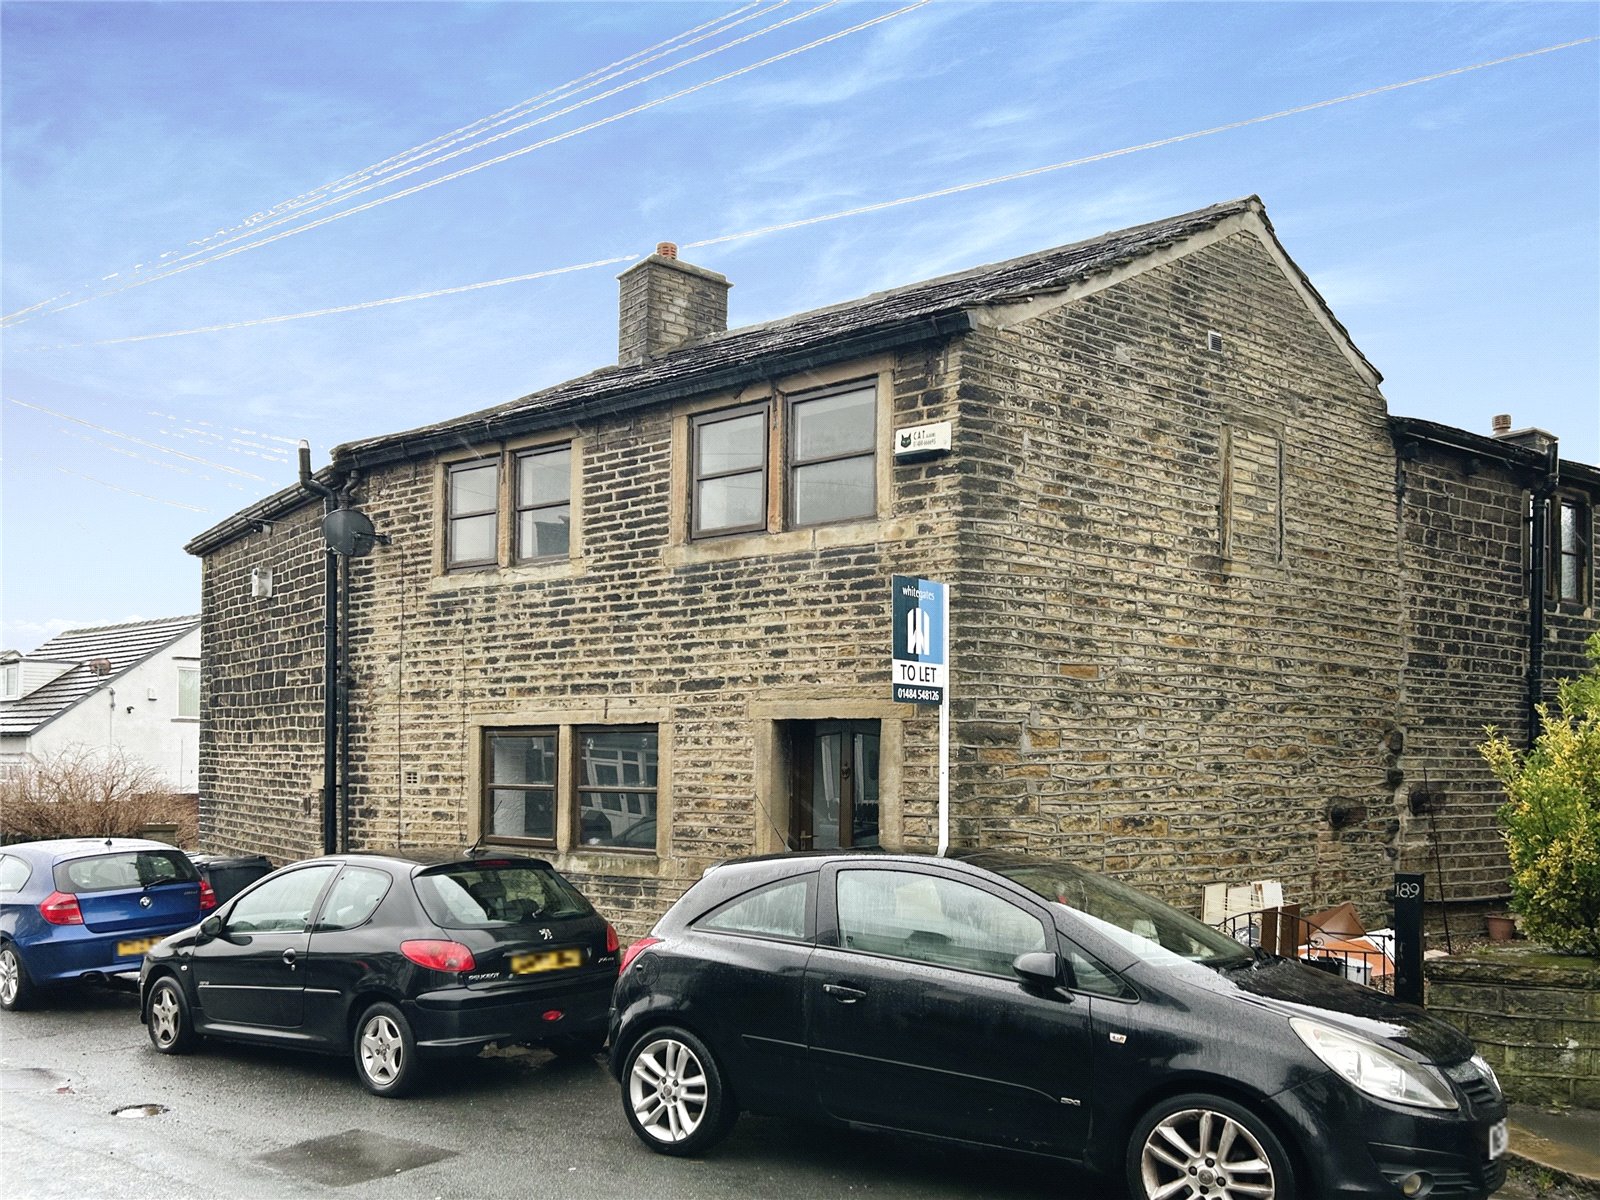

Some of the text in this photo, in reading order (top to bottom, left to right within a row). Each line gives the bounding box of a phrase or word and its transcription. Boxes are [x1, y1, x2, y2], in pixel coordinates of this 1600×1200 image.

[900, 664, 936, 683] TO LET
[897, 688, 917, 699] 01484
[1395, 882, 1420, 898] 189
